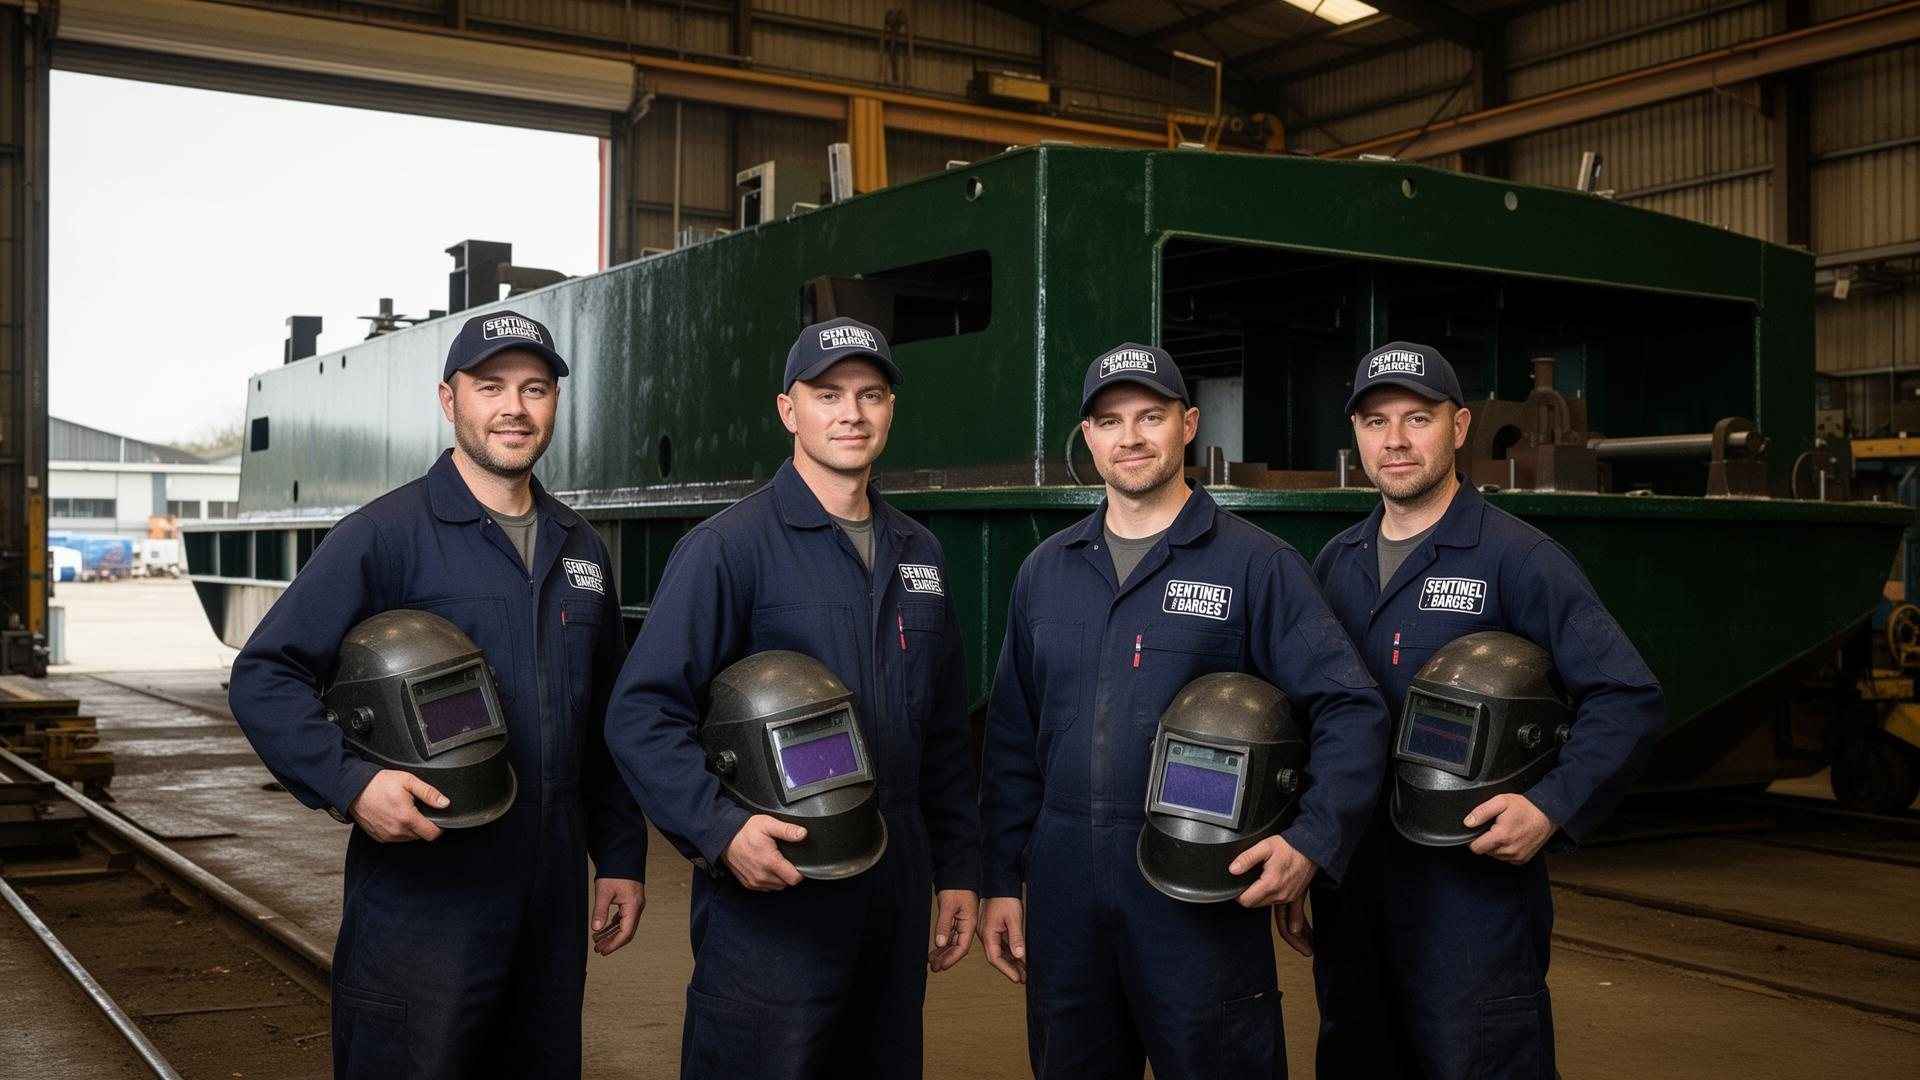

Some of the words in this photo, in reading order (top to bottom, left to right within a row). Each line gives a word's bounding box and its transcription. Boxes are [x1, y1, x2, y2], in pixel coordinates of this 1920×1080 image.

[1102, 351, 1153, 369] SENTINEL
[1372, 352, 1421, 368] SENTINEL
[1168, 583, 1227, 603] SENTINEL
[1426, 580, 1483, 598] SENTINEL
[1178, 598, 1223, 616] BARGES
[1431, 594, 1474, 610] BARGES
